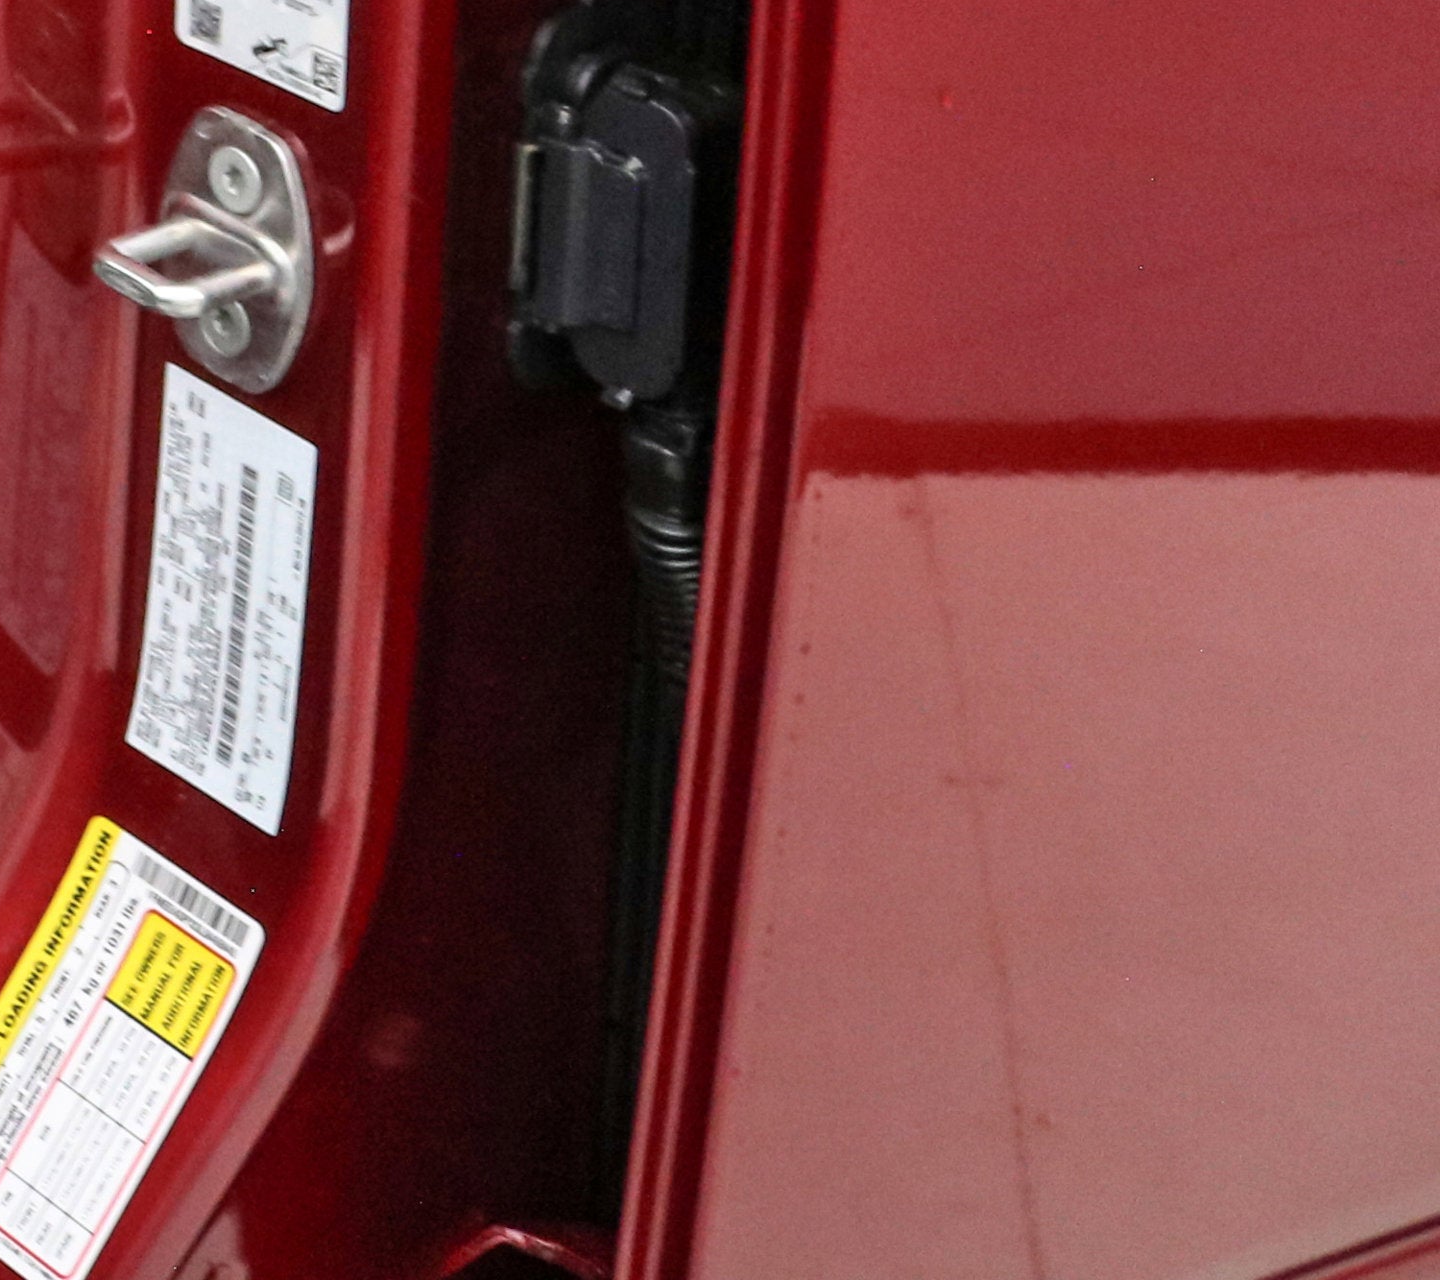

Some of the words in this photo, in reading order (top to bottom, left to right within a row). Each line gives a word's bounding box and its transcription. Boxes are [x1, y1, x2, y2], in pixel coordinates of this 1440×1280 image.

[40, 830, 116, 956] INFORMATION
[121, 984, 138, 1007] SEE
[139, 970, 171, 1021] MANUAL
[166, 942, 186, 969] FOR
[160, 959, 203, 1032] ADDITIONAL
[177, 963, 227, 1049] INFORMATION
